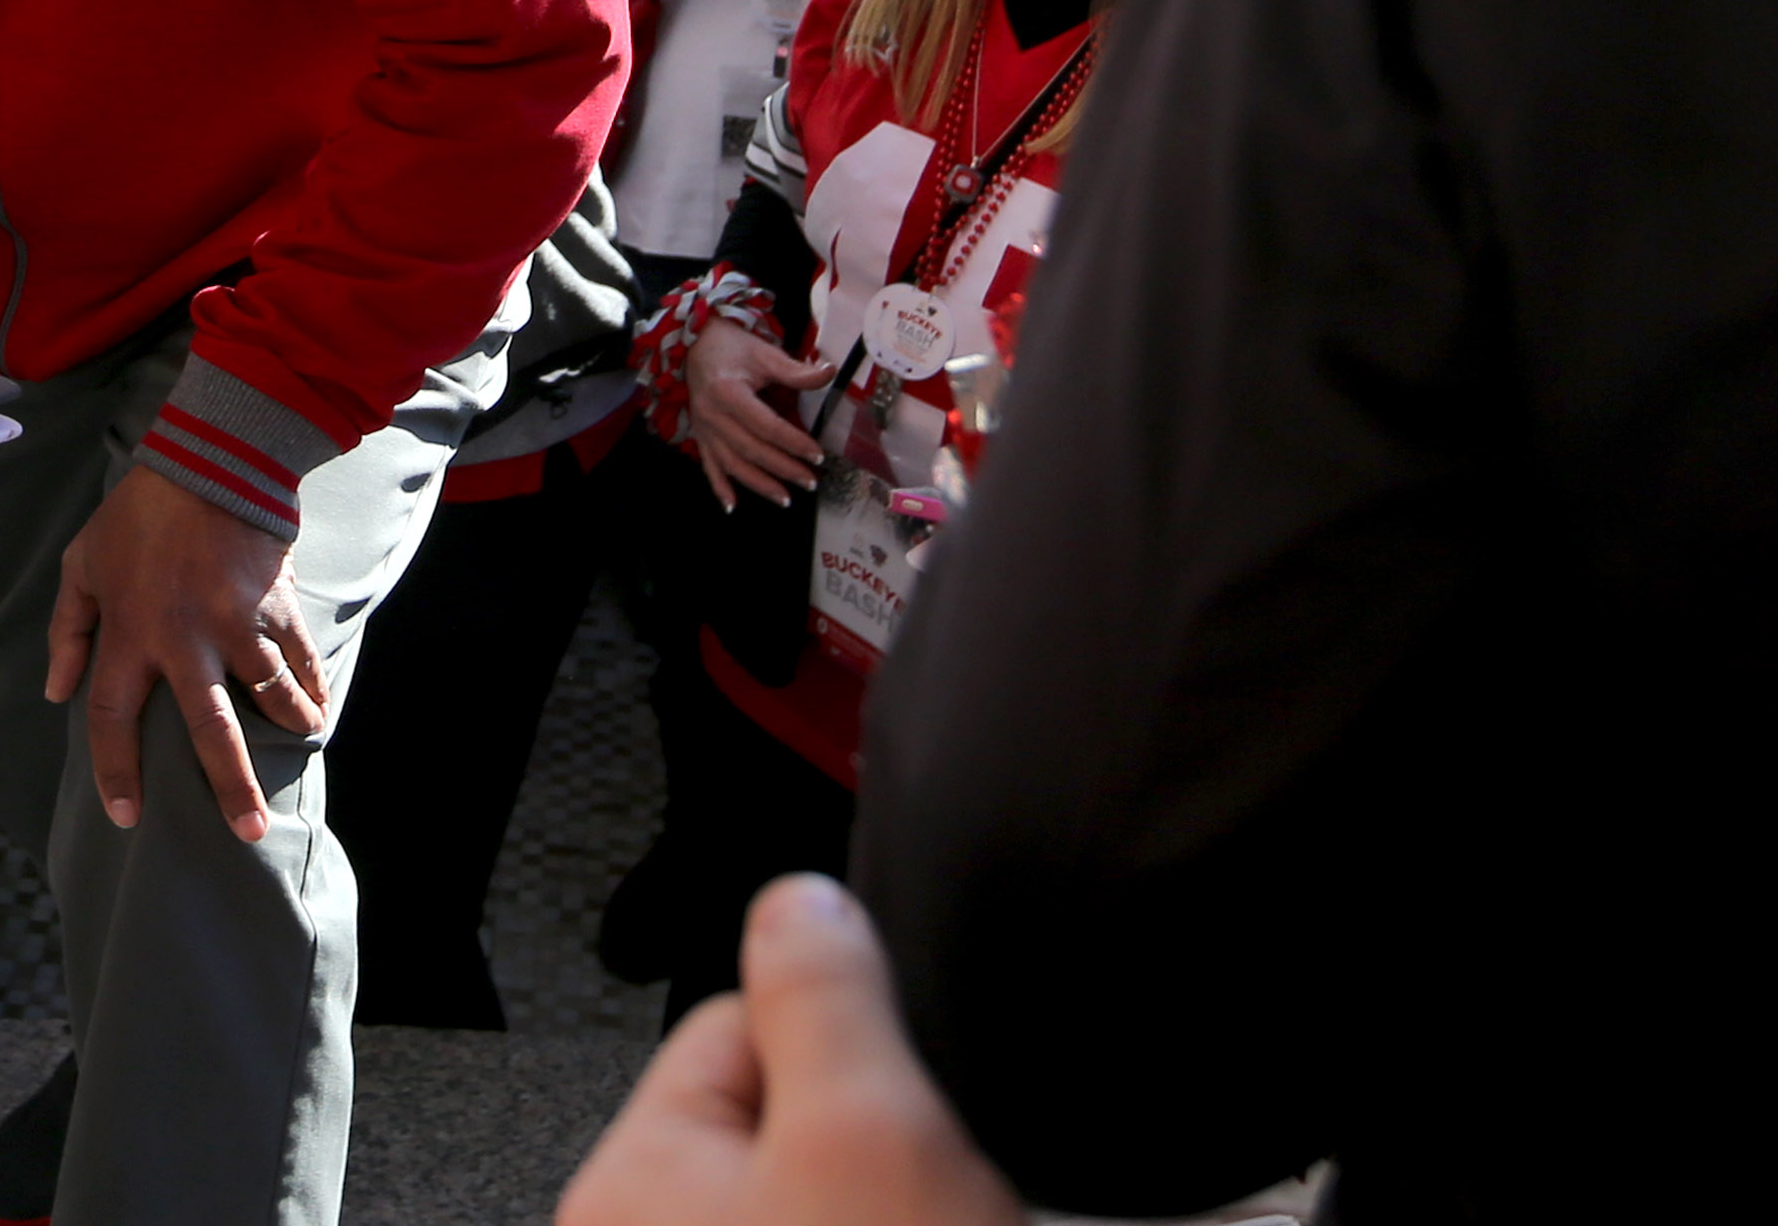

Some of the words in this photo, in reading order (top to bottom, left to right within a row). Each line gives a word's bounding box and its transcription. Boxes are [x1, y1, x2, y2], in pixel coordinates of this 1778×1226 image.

[897, 310, 942, 340] BUCKEYE
[820, 551, 908, 616] BUCKEYE
[824, 570, 896, 634] BASH
